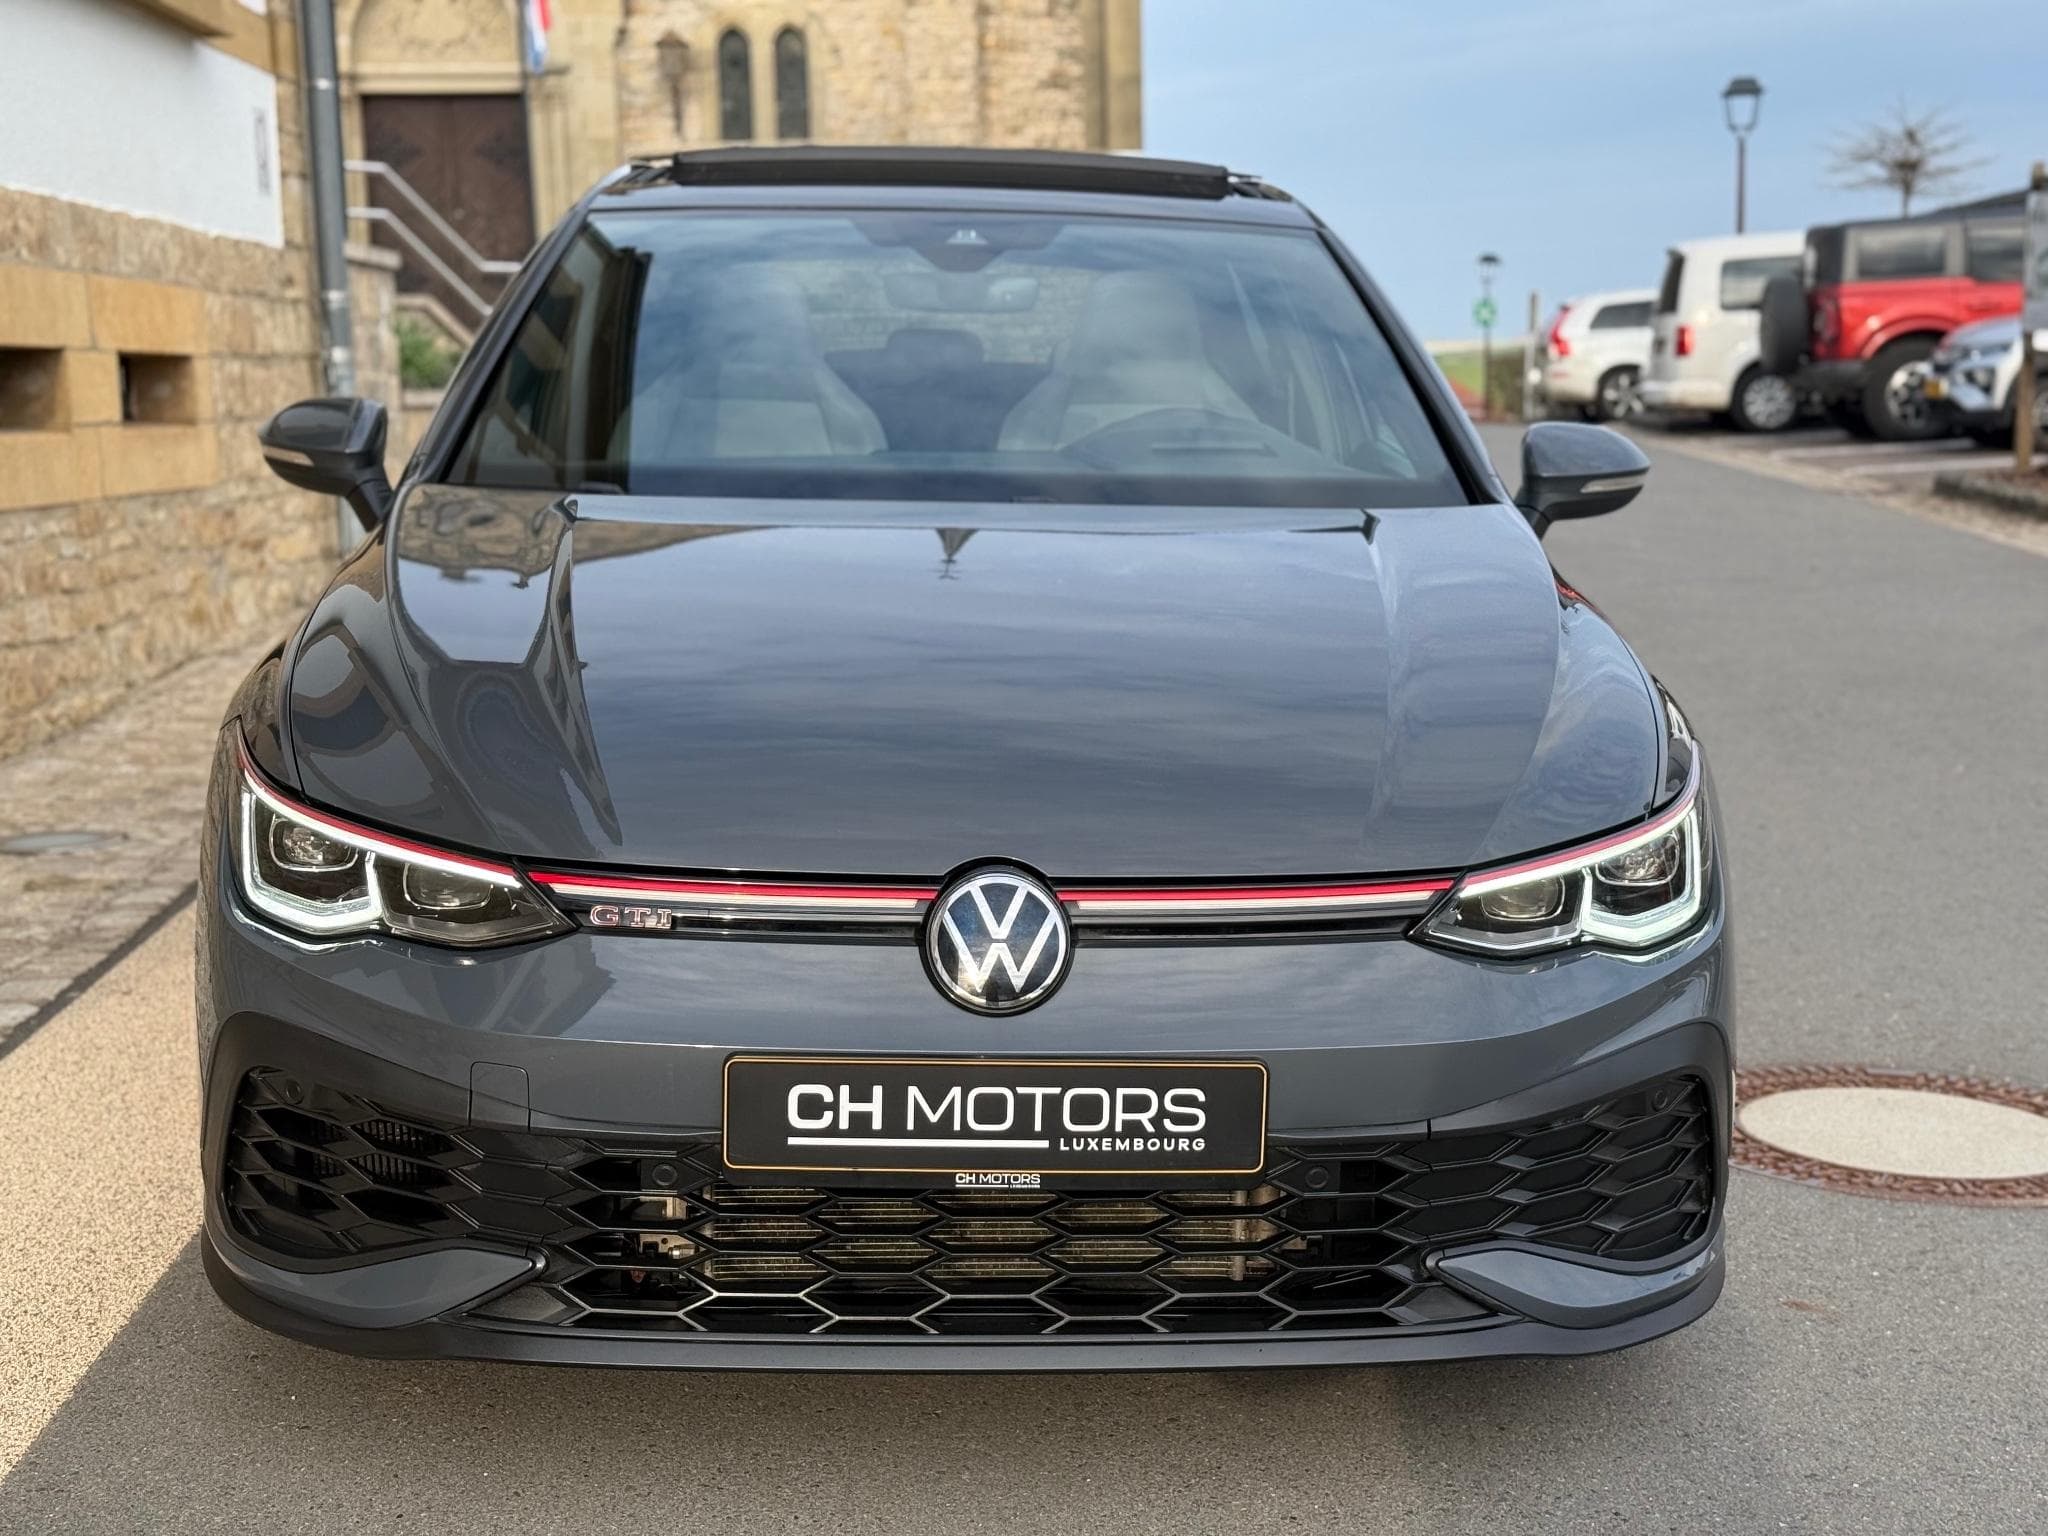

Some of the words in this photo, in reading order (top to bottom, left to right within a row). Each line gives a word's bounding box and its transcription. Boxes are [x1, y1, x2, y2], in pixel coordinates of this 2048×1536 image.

[590, 905, 672, 929] GTI
[787, 1084, 883, 1131] CH
[907, 1086, 1206, 1133] MOTORS
[1060, 1138, 1206, 1151] LUXEMBOURG
[955, 1173, 975, 1184] CH
[979, 1173, 1041, 1184] MOTORS
